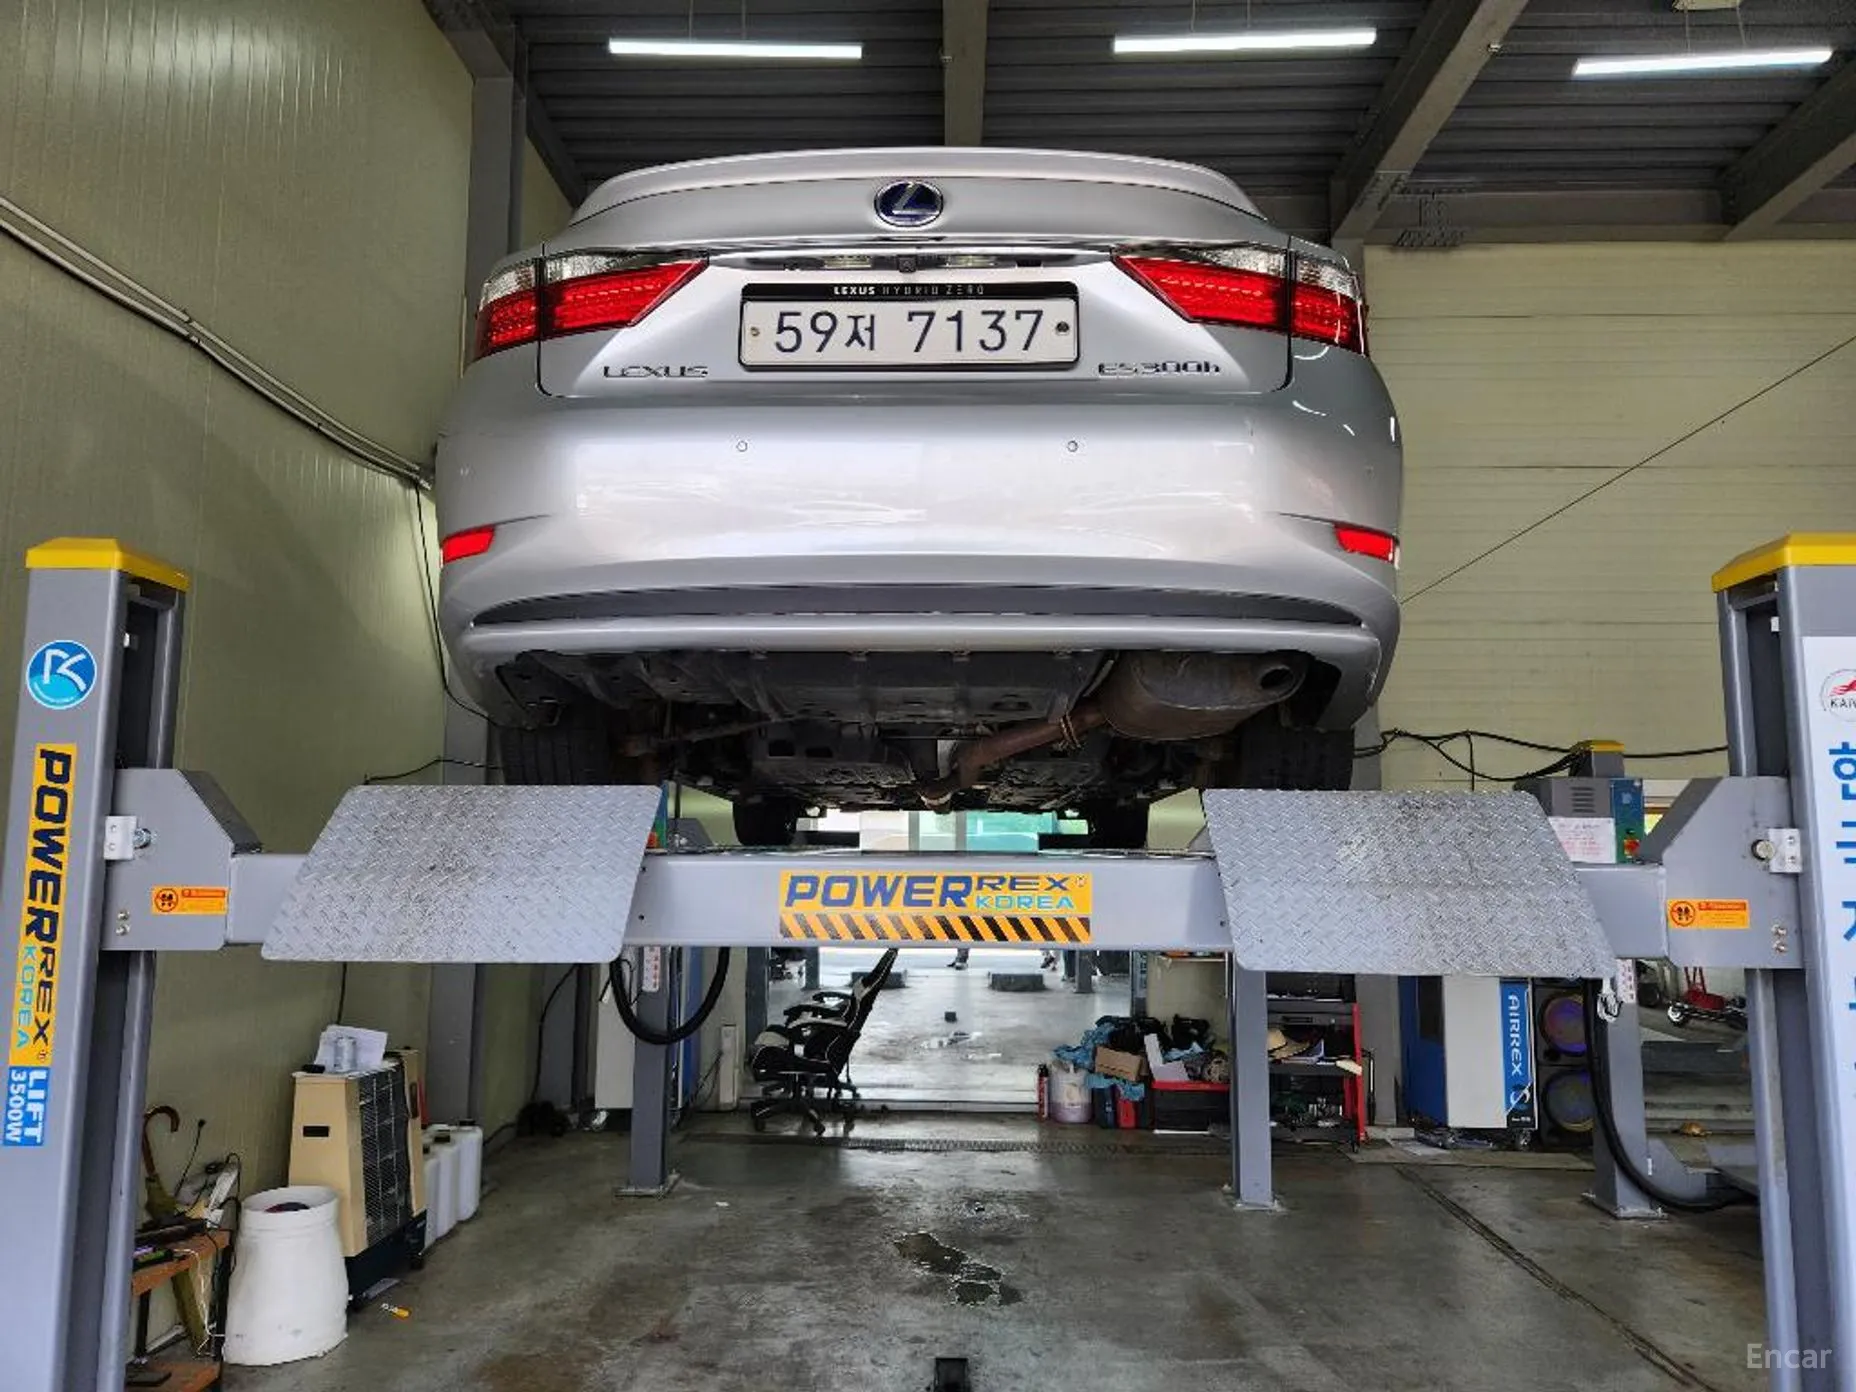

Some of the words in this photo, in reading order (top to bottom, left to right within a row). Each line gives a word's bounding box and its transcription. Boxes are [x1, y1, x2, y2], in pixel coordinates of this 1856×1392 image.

[833, 285, 876, 296] LEXUS
[774, 310, 876, 353] 59저
[906, 309, 1044, 353] 7137
[602, 365, 709, 379] LEXUS
[974, 894, 1075, 910] KOREA
[16, 945, 37, 1048] KOREA
[1507, 993, 1523, 1077] AIRREX
[5, 1068, 28, 1143] 3500W
[23, 1069, 48, 1144] LIFT
